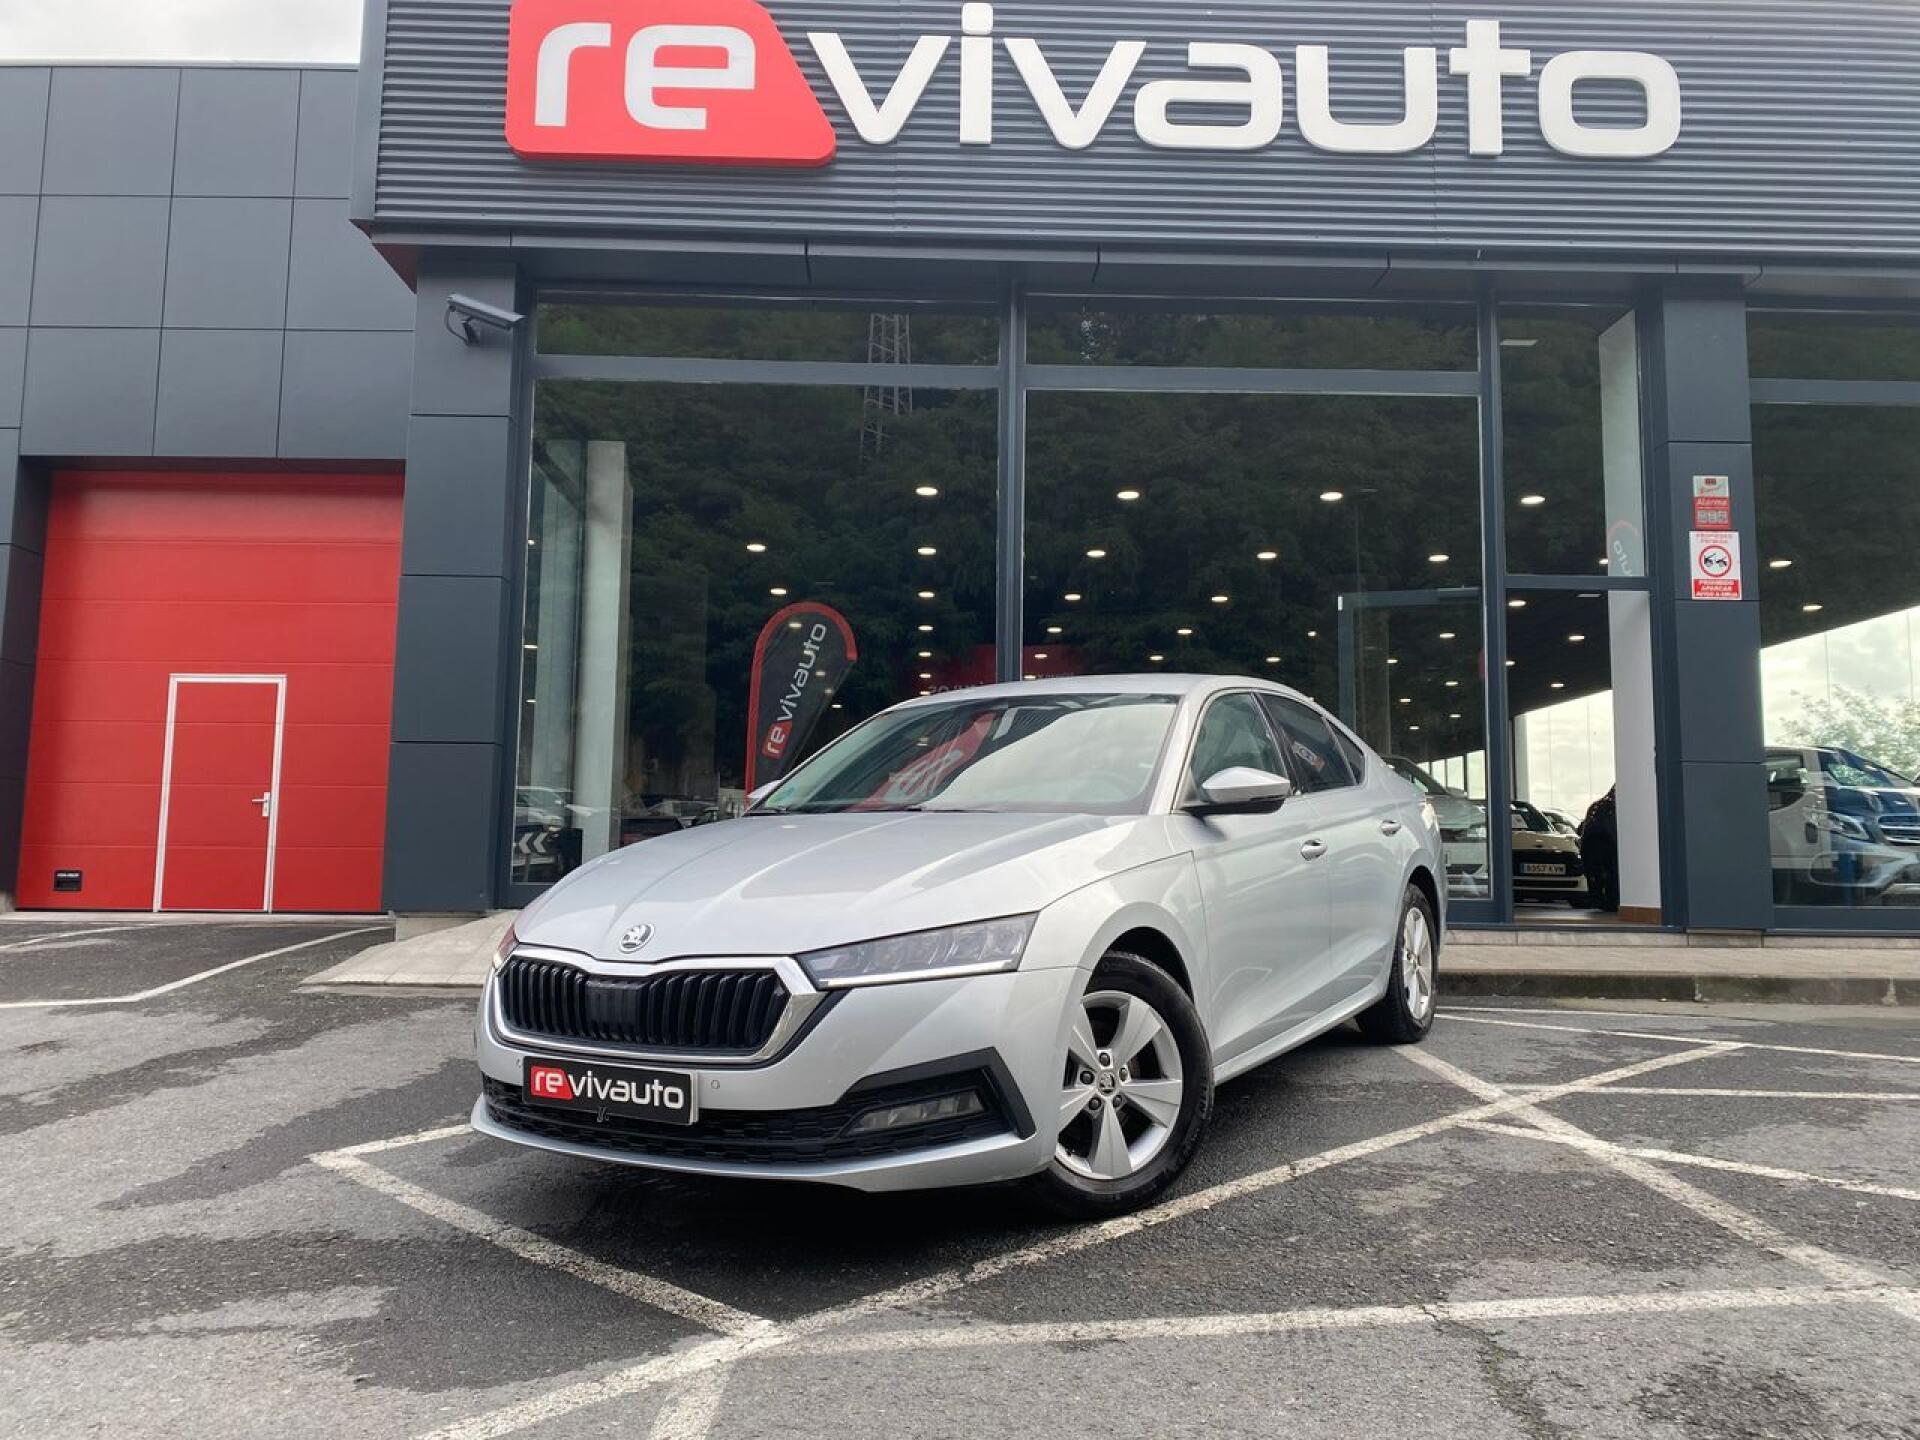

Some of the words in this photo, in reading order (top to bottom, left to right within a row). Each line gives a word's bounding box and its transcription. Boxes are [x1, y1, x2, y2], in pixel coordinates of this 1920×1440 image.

[534, 2, 1681, 158] revivauto
[767, 623, 827, 755] revivauto
[535, 1070, 685, 1110] revivauto
